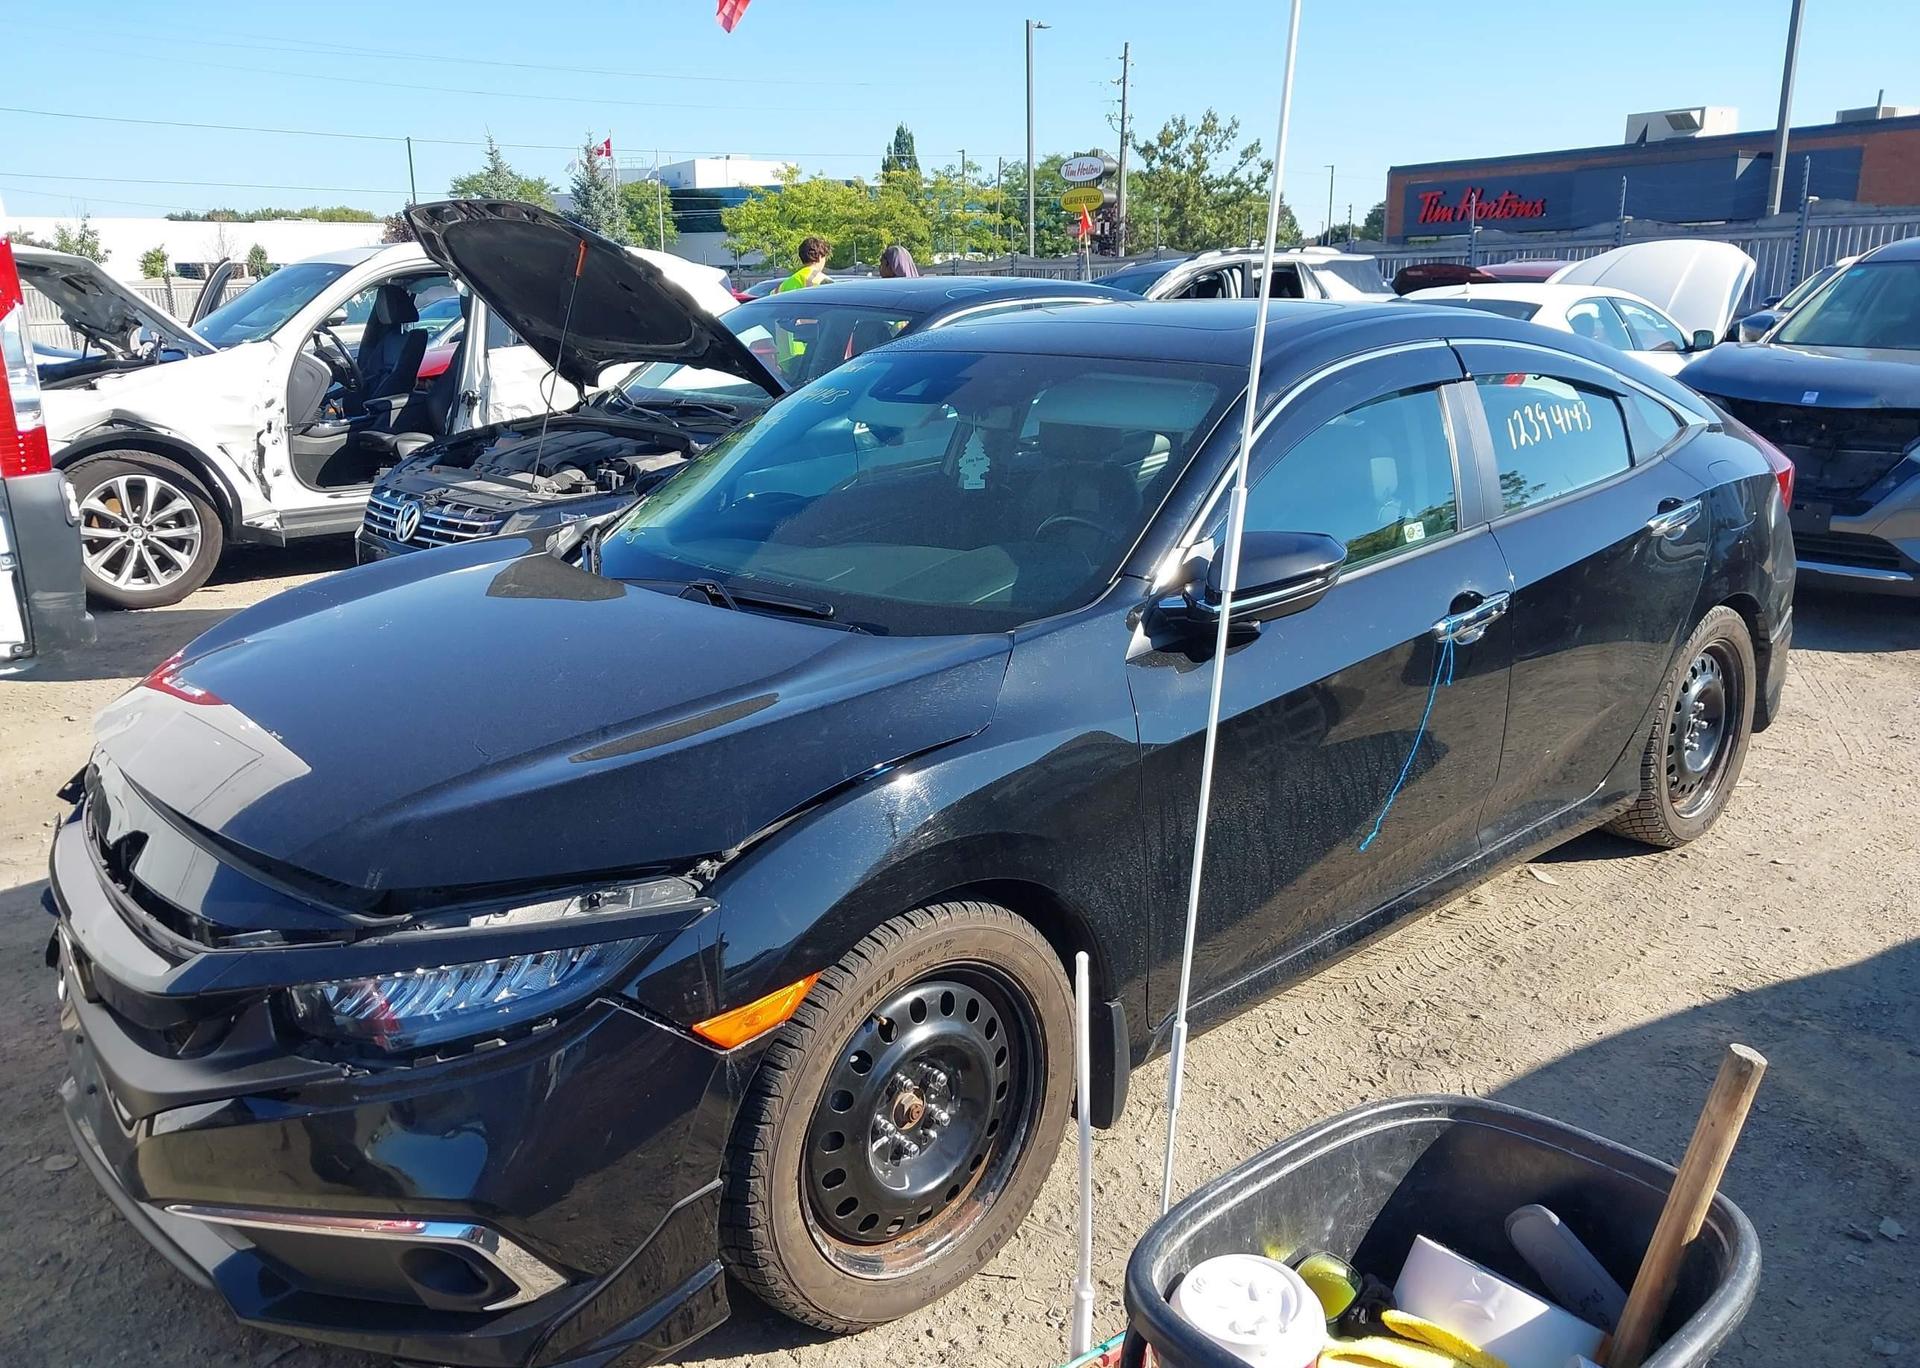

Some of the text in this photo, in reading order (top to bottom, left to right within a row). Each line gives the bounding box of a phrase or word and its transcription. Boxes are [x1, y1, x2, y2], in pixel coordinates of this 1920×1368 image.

[1064, 163, 1077, 177] Tim
[1418, 186, 1546, 223] Tim Hortons
